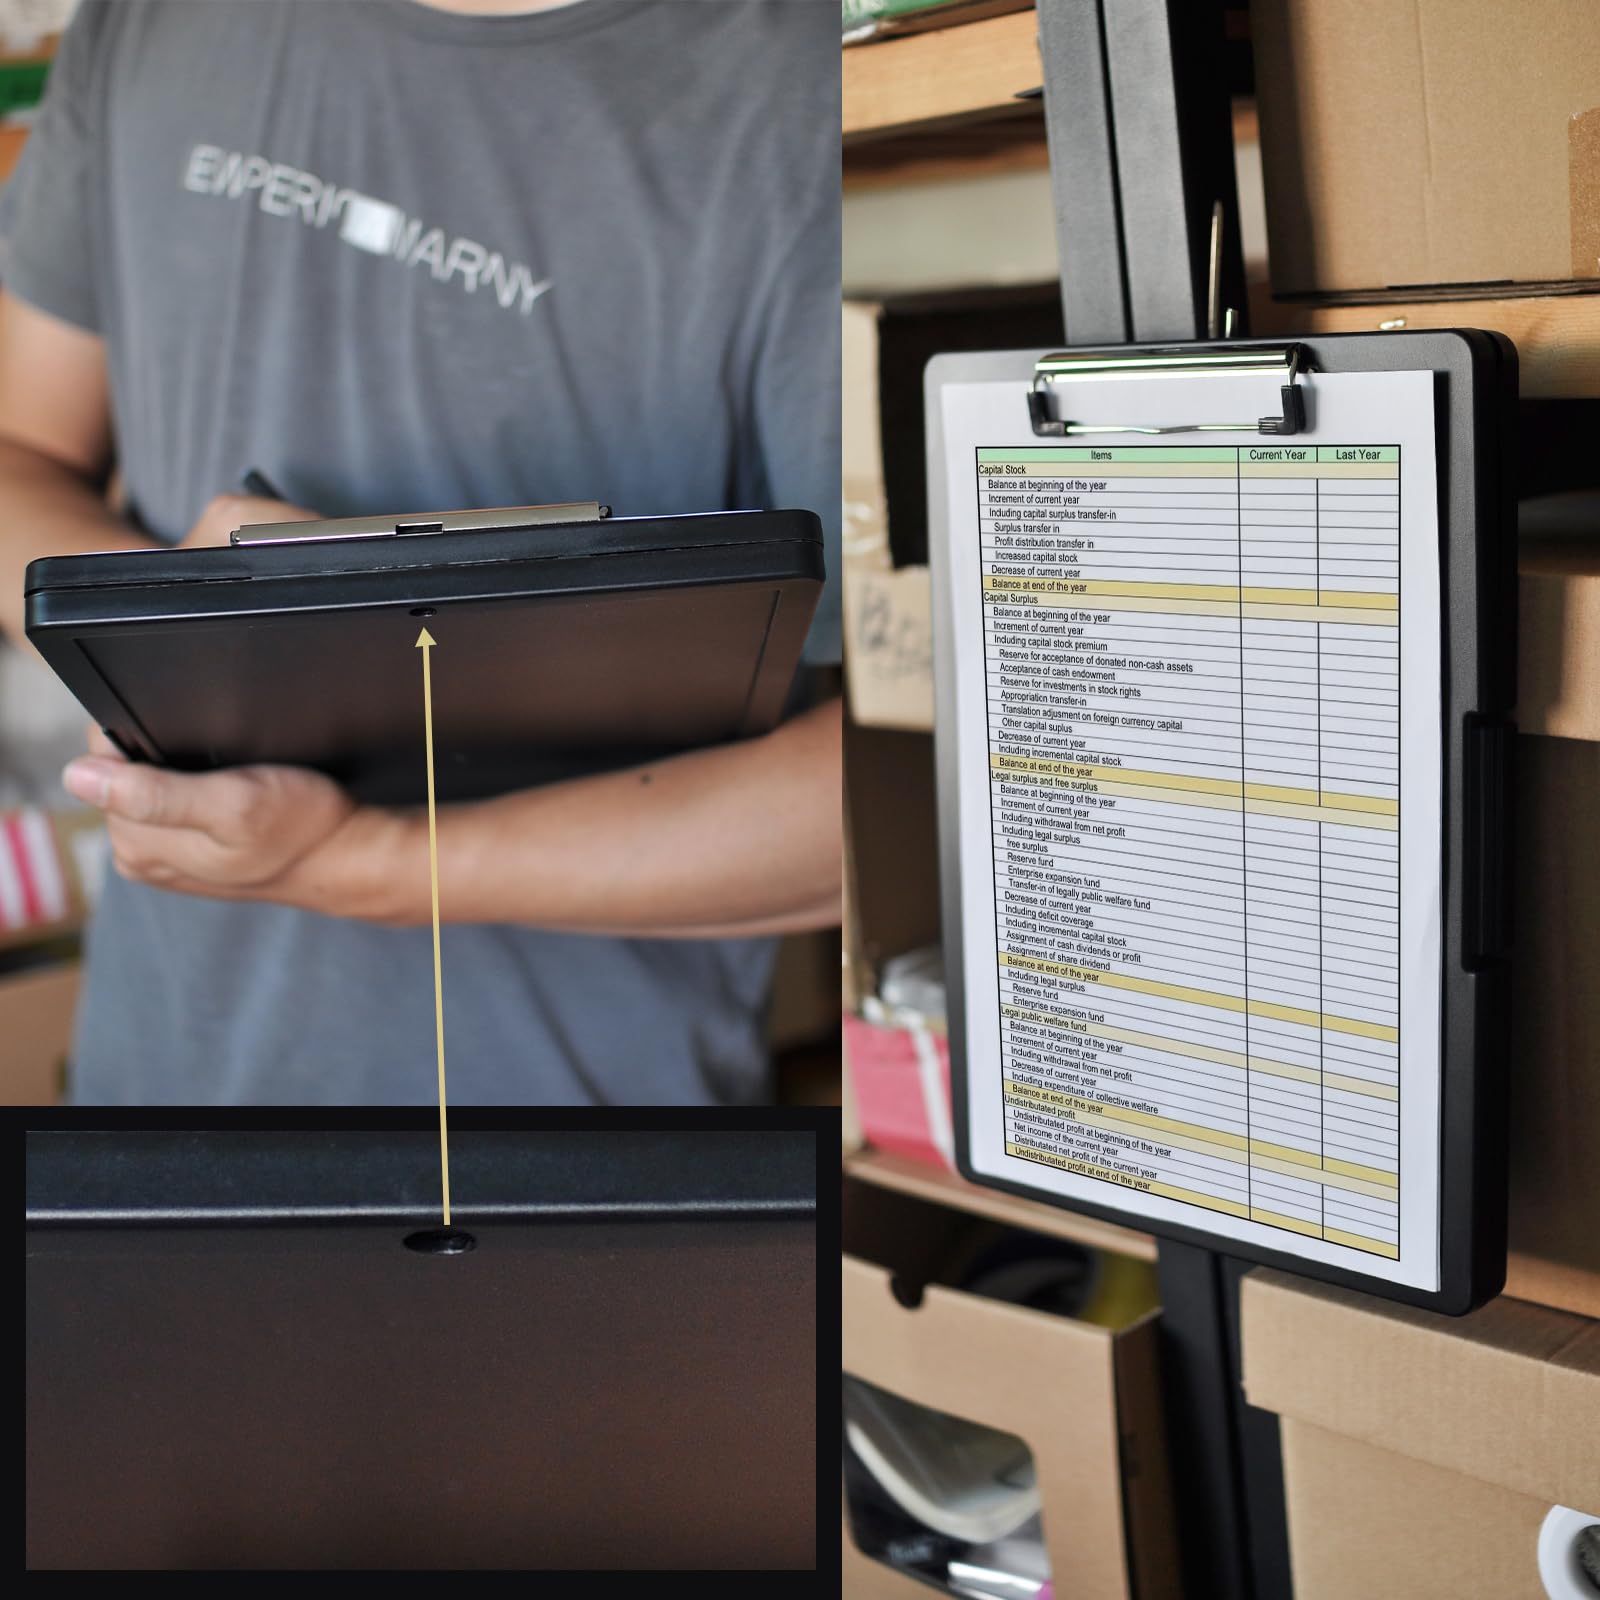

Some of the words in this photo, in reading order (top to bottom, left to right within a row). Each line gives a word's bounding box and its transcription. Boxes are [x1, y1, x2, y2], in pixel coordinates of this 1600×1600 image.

[1091, 450, 1112, 460] Items
[1249, 450, 1283, 460] Current
[1284, 450, 1306, 460] Year
[1336, 450, 1356, 460] Last
[1359, 450, 1381, 460] Year
[978, 465, 1004, 476] Capital
[1005, 465, 1026, 474] Stock
[988, 479, 1017, 488] Balance
[1019, 480, 1026, 488] at
[1028, 480, 1064, 491] beginning
[1066, 480, 1074, 489] of
[1075, 480, 1088, 489] the
[1089, 482, 1107, 491] year
[988, 494, 1024, 503] Increment
[1026, 494, 1033, 503] of
[1035, 495, 1061, 503] current
[1062, 497, 1079, 506] year
[989, 508, 1021, 519] Including
[1023, 509, 1047, 520] capital
[1048, 509, 1076, 520] surplus
[1077, 510, 1116, 519] transfer-in
[993, 522, 1021, 533] Surplus
[1022, 523, 1051, 532] transfer
[1052, 523, 1059, 532] in
[994, 537, 1013, 545] Profit
[1015, 537, 1054, 547] distribution
[1056, 539, 1084, 548] transfer
[1086, 539, 1093, 548] in
[995, 551, 1030, 560] Increased
[1032, 552, 1056, 563] capital
[1058, 553, 1078, 562] stock
[991, 565, 1025, 574] Decrease
[1027, 566, 1034, 575] of
[1036, 568, 1062, 576] current
[1063, 569, 1080, 578] year
[992, 579, 1021, 588] Balance
[1022, 581, 1030, 589] at
[1031, 581, 1045, 589] end
[1047, 581, 1054, 590] of
[1056, 581, 1068, 591] the
[1070, 584, 1086, 593] year
[983, 592, 1009, 603] Capital
[1010, 593, 1038, 605] Surplus
[994, 634, 1026, 647] Including
[1027, 637, 1051, 648] capital
[1053, 639, 1073, 648] stock
[1074, 641, 1107, 651] premium
[999, 649, 1029, 659] Reserve
[1030, 651, 1040, 660] for
[1042, 653, 1084, 664] acceptance
[1086, 655, 1094, 664] of
[1095, 655, 1126, 666] donated
[1128, 660, 1164, 669] non-cash
[1166, 663, 1193, 671] assets
[999, 662, 1041, 674] Acceptance
[1042, 666, 1050, 674] of
[1051, 667, 1069, 676] cash
[1071, 668, 1115, 680] endowment
[1000, 676, 1030, 687] Reserve
[1031, 678, 1041, 688] for
[1043, 679, 1087, 692] investments
[1088, 683, 1096, 692] in
[1097, 685, 1117, 694] stock
[1119, 686, 1141, 698] rights
[1000, 690, 1047, 702] Appropriation
[1049, 695, 1086, 706] transfer-in
[1001, 704, 1040, 715] Translation
[1093, 712, 1119, 725] foreign
[1121, 717, 1154, 729] currency
[1156, 719, 1182, 730] capital
[1001, 717, 1021, 727] Other
[1023, 720, 1047, 731] capital
[998, 744, 1030, 758] Including
[1031, 747, 1073, 760] incremental
[1075, 754, 1099, 764] capital
[1101, 756, 1121, 766] stock
[991, 770, 1010, 782] Legal
[1012, 774, 1038, 784] surplus
[1039, 777, 1053, 786] and
[1054, 777, 1069, 788] free
[1070, 781, 1097, 792] surplus
[1000, 798, 1036, 810] Increment
[1037, 803, 1044, 812] of
[1046, 806, 1071, 815] current
[1073, 809, 1089, 818] year
[1001, 811, 1033, 826] Including
[1034, 816, 1072, 829] withdrawal
[1074, 821, 1091, 832] from
[1092, 825, 1104, 834] net
[1106, 827, 1125, 837] profit
[1001, 825, 1033, 839] Including
[1034, 829, 1052, 841] legal
[1053, 834, 1080, 844] surplus
[1007, 852, 1036, 864] Reserve
[1037, 856, 1053, 867] fund
[1007, 865, 1043, 879] Enterprise
[1045, 873, 1082, 885] expansion
[1083, 877, 1100, 888] fund
[1005, 904, 1036, 919] Including
[1037, 910, 1058, 921] deficit
[1060, 915, 1093, 929] coverage
[1005, 930, 1046, 945] Assignment
[1048, 939, 1055, 947] of
[1056, 941, 1074, 950] cash
[1075, 943, 1110, 957] dividends
[1112, 951, 1120, 959] or
[1121, 953, 1140, 963] profit
[1006, 943, 1047, 959] Assignment
[1048, 952, 1056, 960] of
[1057, 953, 1078, 965] share
[1079, 957, 1110, 971] dividend
[1000, 1006, 1020, 1019] Legal
[1021, 1012, 1042, 1023] public
[1043, 1017, 1069, 1028] welfare
[1070, 1021, 1086, 1032] fund
[1011, 1059, 1044, 1074] Decrease
[1045, 1068, 1052, 1076] of
[1054, 1071, 1079, 1083] current
[1080, 1077, 1096, 1087] year
[1011, 1072, 1043, 1089] Including
[1044, 1081, 1085, 1097] expenditure
[1086, 1091, 1094, 1099] of
[1095, 1093, 1129, 1107] collective
[1131, 1102, 1158, 1114] welfare
[1012, 1085, 1040, 1099] Balance
[1041, 1093, 1049, 1101] at
[1050, 1095, 1064, 1105] end
[1065, 1098, 1072, 1107] of
[1074, 1100, 1085, 1110] the
[1087, 1104, 1103, 1114] year
[1057, 1110, 1075, 1120] profit
[1014, 1123, 1026, 1133] Net
[1027, 1126, 1052, 1140] income
[1054, 1134, 1061, 1142] of
[1062, 1135, 1074, 1145] the
[1075, 1140, 1100, 1152] current
[1102, 1147, 1118, 1157] year
[1068, 1163, 1086, 1174] profit
[1087, 1168, 1094, 1176] at
[1096, 1171, 1110, 1180] end
[1111, 1174, 1119, 1183] of
[1120, 1176, 1132, 1186] the
[1134, 1181, 1150, 1191] year
